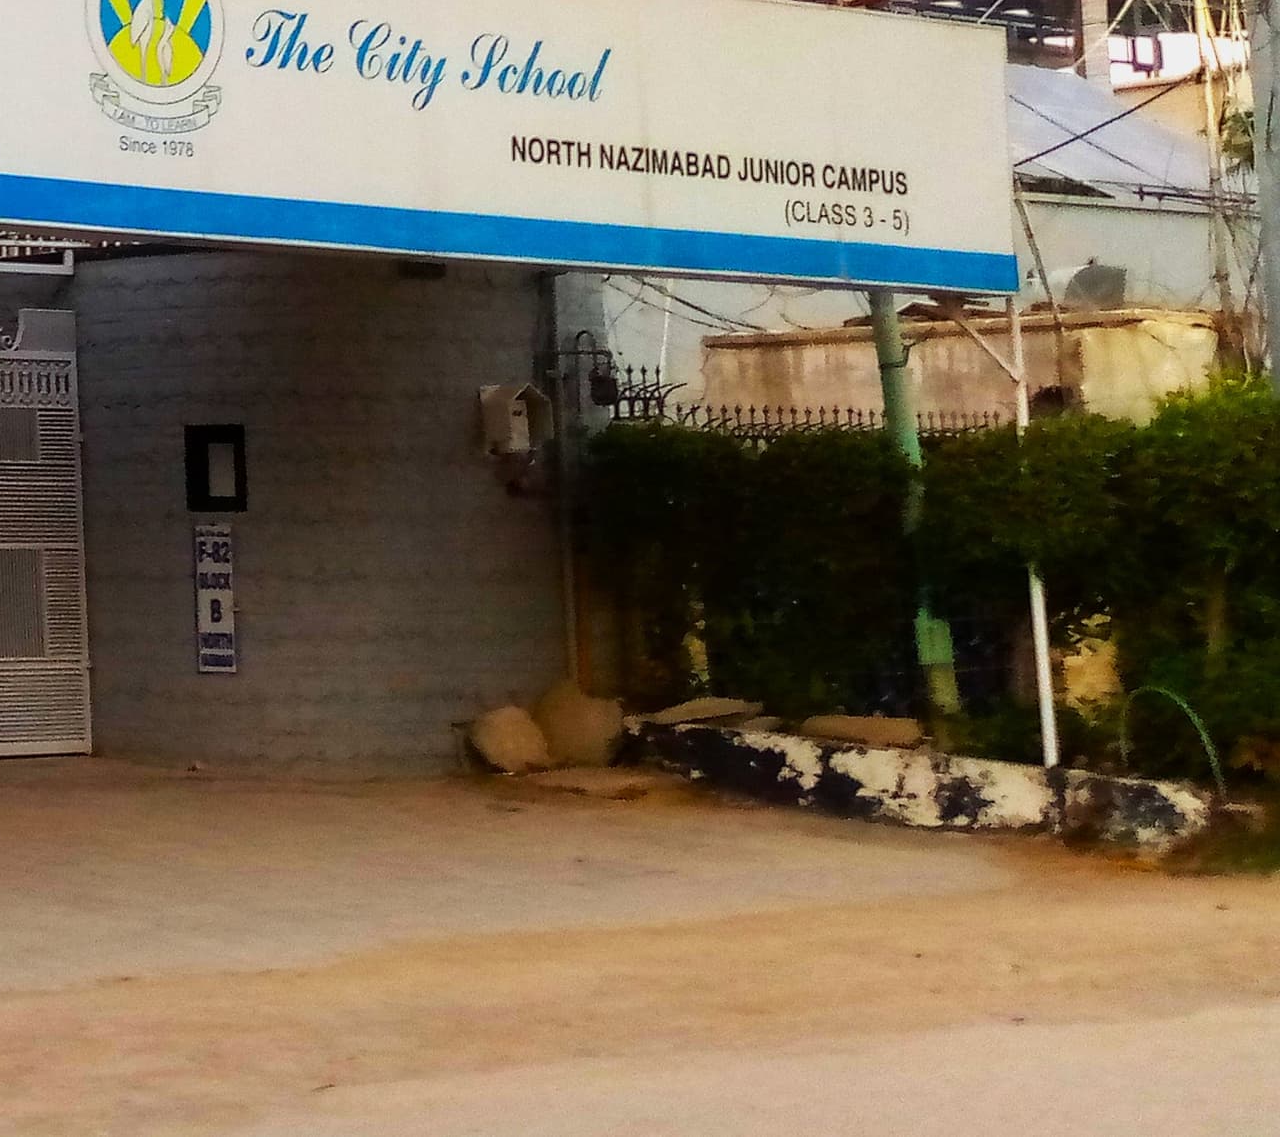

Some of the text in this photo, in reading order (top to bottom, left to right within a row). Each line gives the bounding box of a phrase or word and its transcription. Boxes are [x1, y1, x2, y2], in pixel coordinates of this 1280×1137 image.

[245, 9, 611, 111] The City School
[119, 135, 194, 157] Since 1978
[511, 135, 908, 195] NORTH NAZIMABAD JUNIOR CAMPUS
[785, 199, 856, 227] (CLASS
[863, 206, 873, 228] 3
[893, 208, 910, 236] 5)
[210, 598, 222, 623] B
